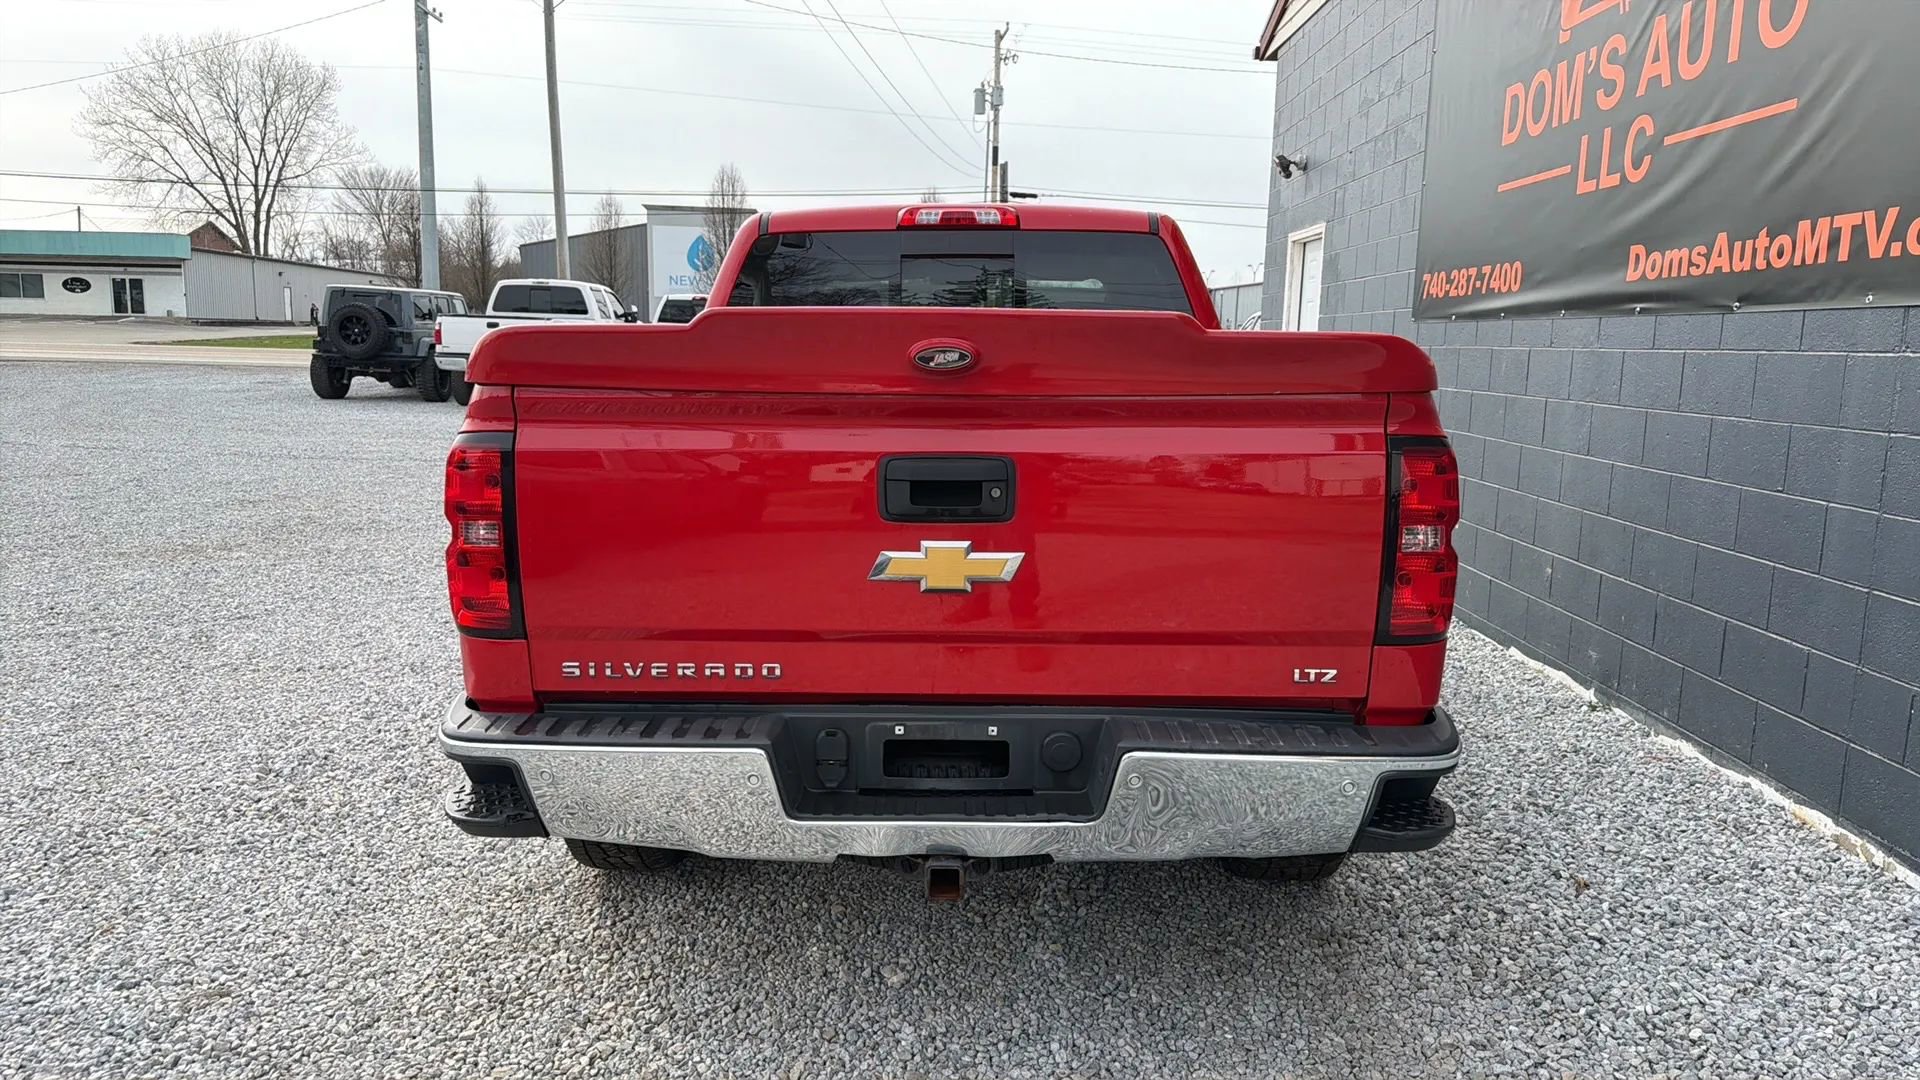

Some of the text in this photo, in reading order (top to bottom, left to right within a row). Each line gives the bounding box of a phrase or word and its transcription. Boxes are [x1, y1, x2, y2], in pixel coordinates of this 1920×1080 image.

[1501, 34, 1627, 146] DOM'S
[1576, 114, 1655, 195] LLC
[1422, 261, 1523, 299] 740-287-7400
[928, 351, 960, 366] JASON
[561, 661, 782, 678] SILVERADO
[1293, 668, 1338, 683] LTZ
